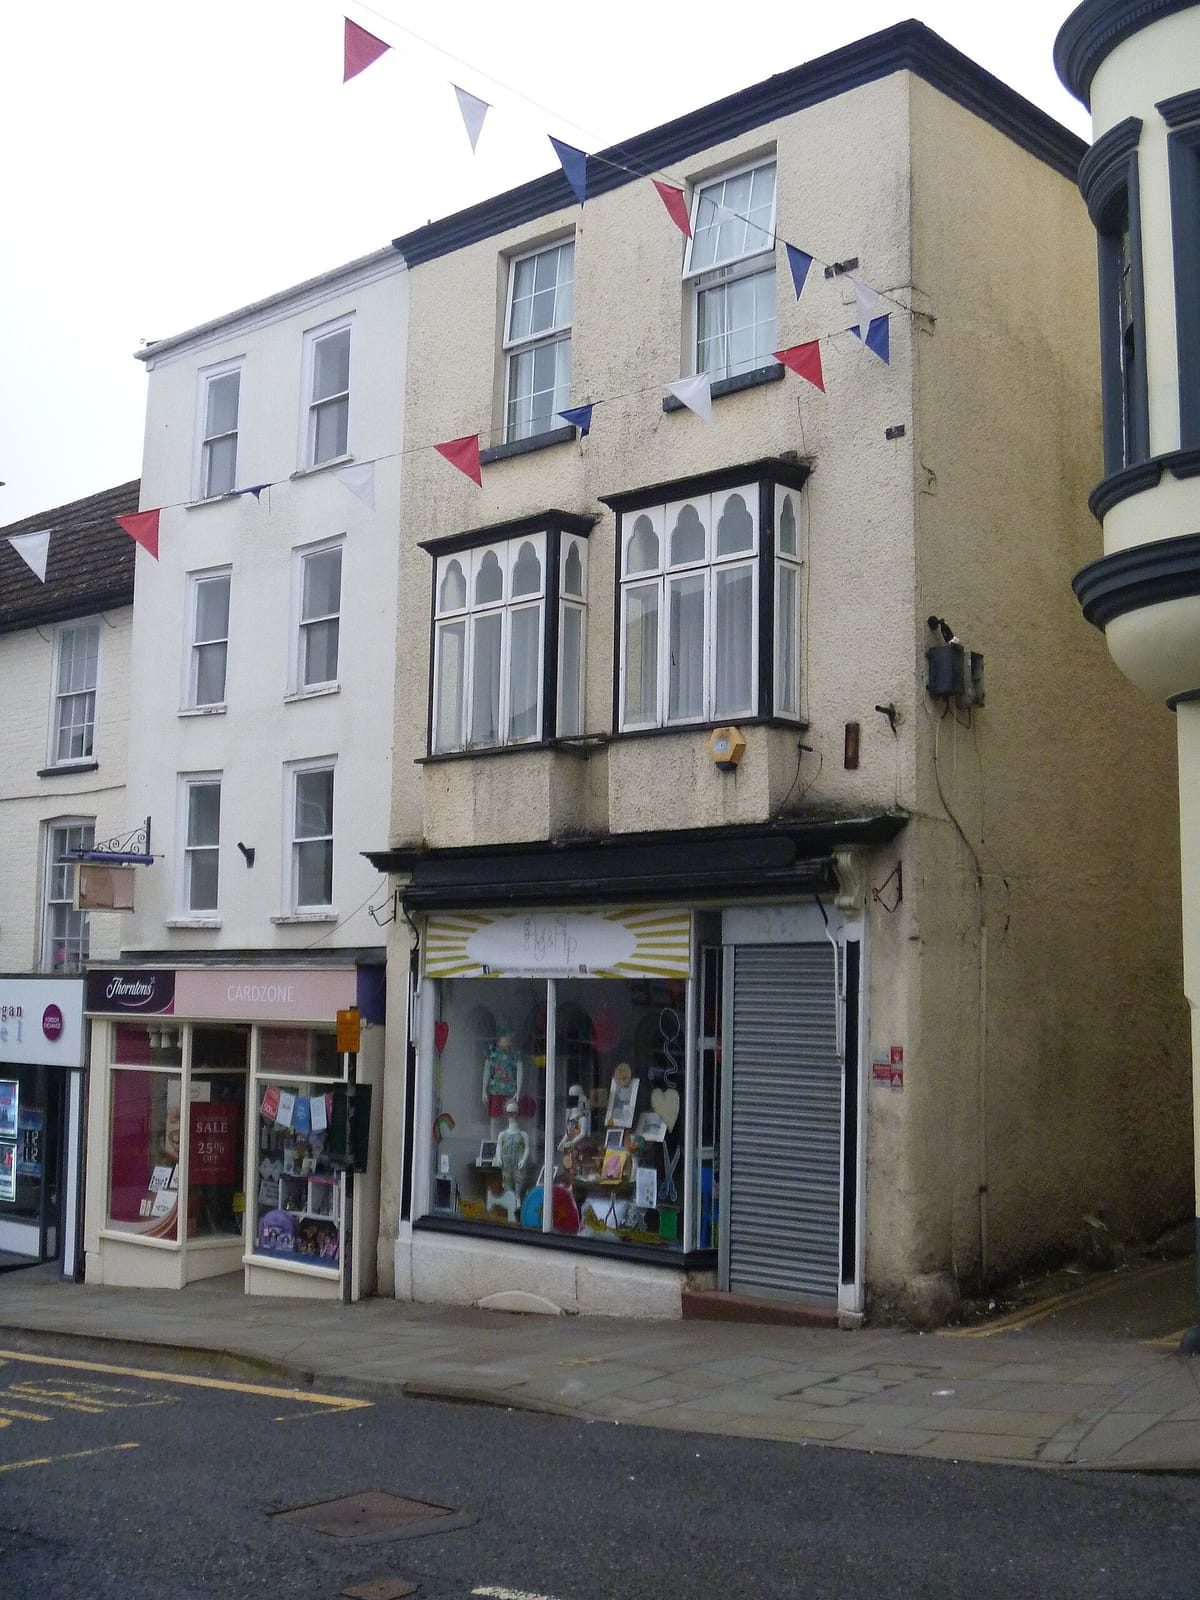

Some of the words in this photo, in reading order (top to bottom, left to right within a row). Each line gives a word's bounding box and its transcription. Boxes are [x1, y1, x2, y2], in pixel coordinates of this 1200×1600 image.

[106, 976, 153, 998] Thorntons
[227, 985, 295, 1002] CARDZONE
[196, 1122, 228, 1133] SALE
[197, 1143, 225, 1154] 25%
